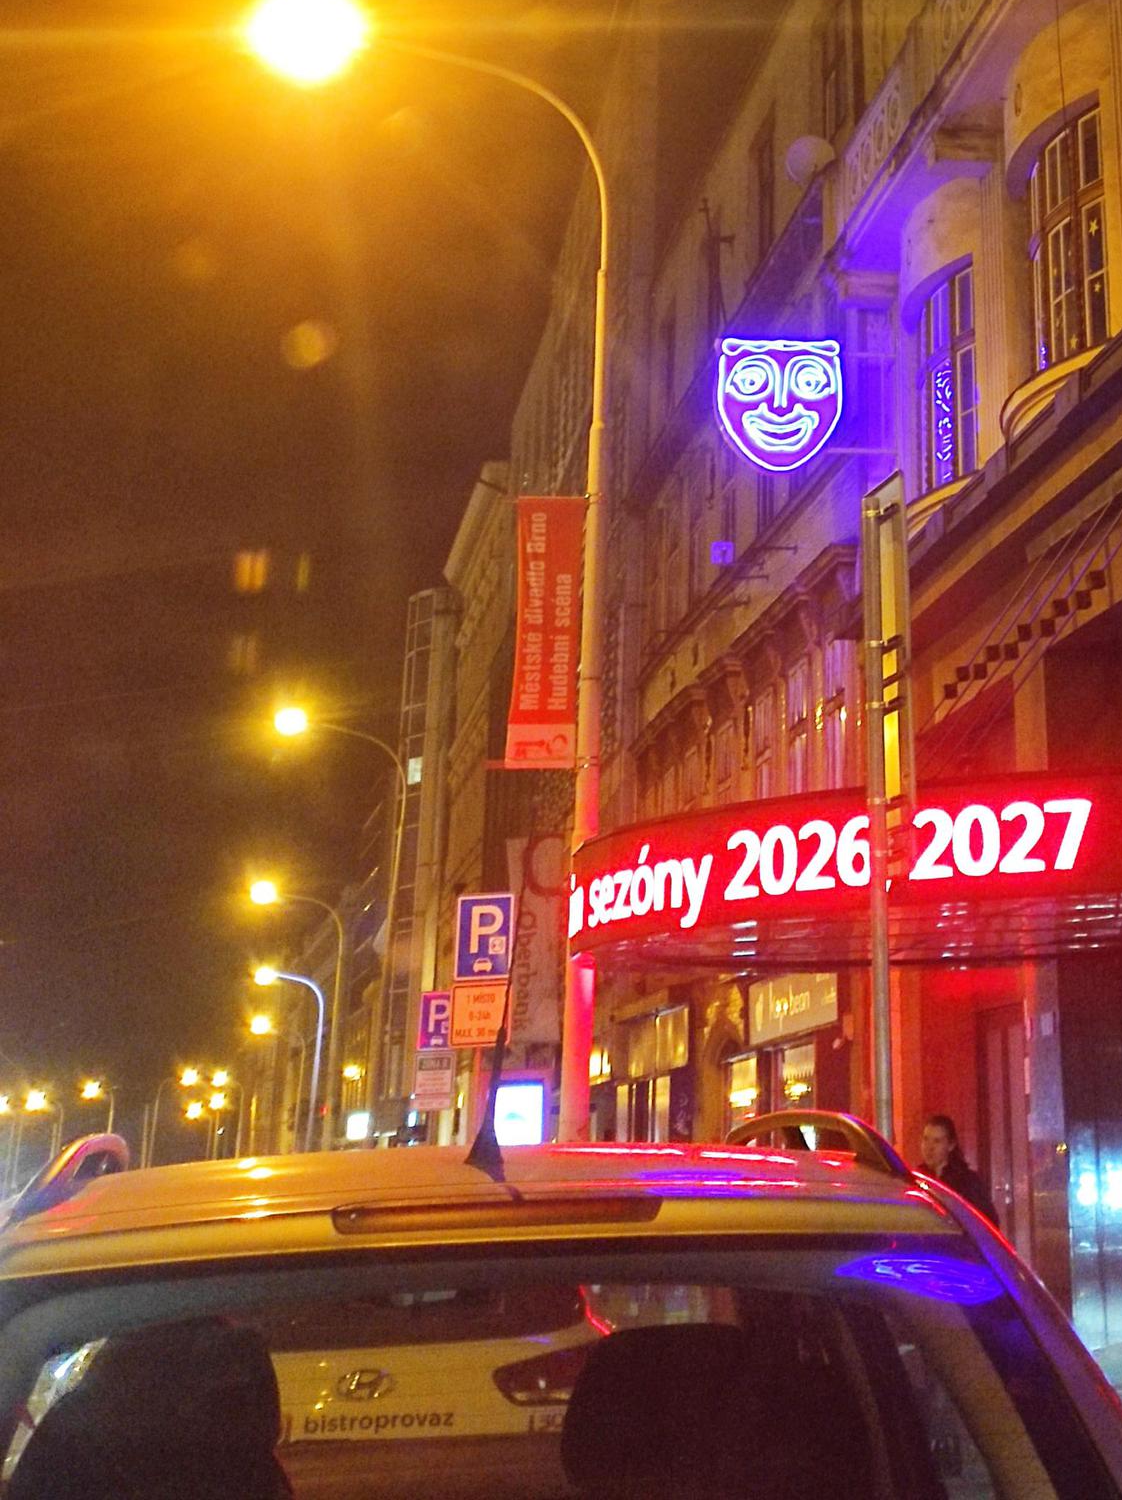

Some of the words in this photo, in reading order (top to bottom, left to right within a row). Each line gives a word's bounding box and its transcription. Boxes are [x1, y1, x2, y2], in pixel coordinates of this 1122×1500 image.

[526, 512, 547, 553] Brno
[524, 561, 544, 625] divadlo
[552, 573, 573, 627] scéna
[519, 632, 542, 710] Městské
[588, 844, 713, 929] sezóny
[908, 798, 1093, 880] 2027
[470, 905, 504, 954] P
[427, 999, 449, 1033] P
[303, 1411, 455, 1434] bistroprovaz
